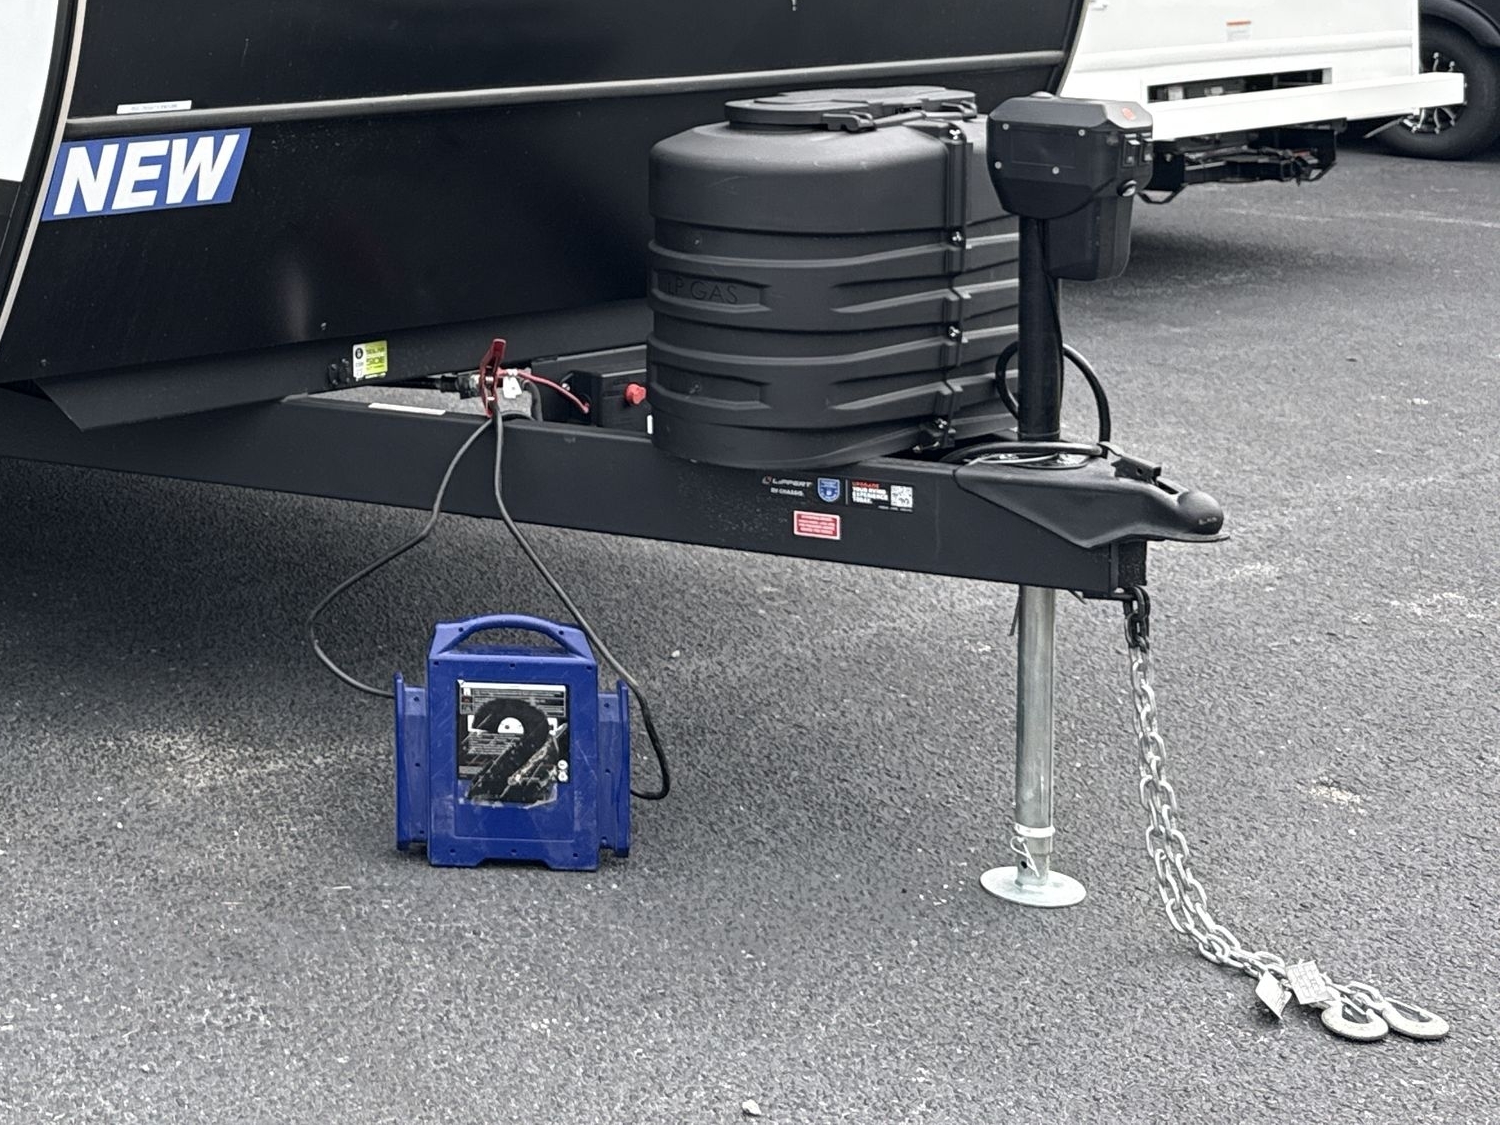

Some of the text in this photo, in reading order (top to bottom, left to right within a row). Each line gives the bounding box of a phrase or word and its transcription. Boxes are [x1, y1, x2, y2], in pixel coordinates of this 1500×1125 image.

[53, 133, 240, 216] NEW
[691, 280, 738, 305] GAS
[467, 698, 550, 802] 2
